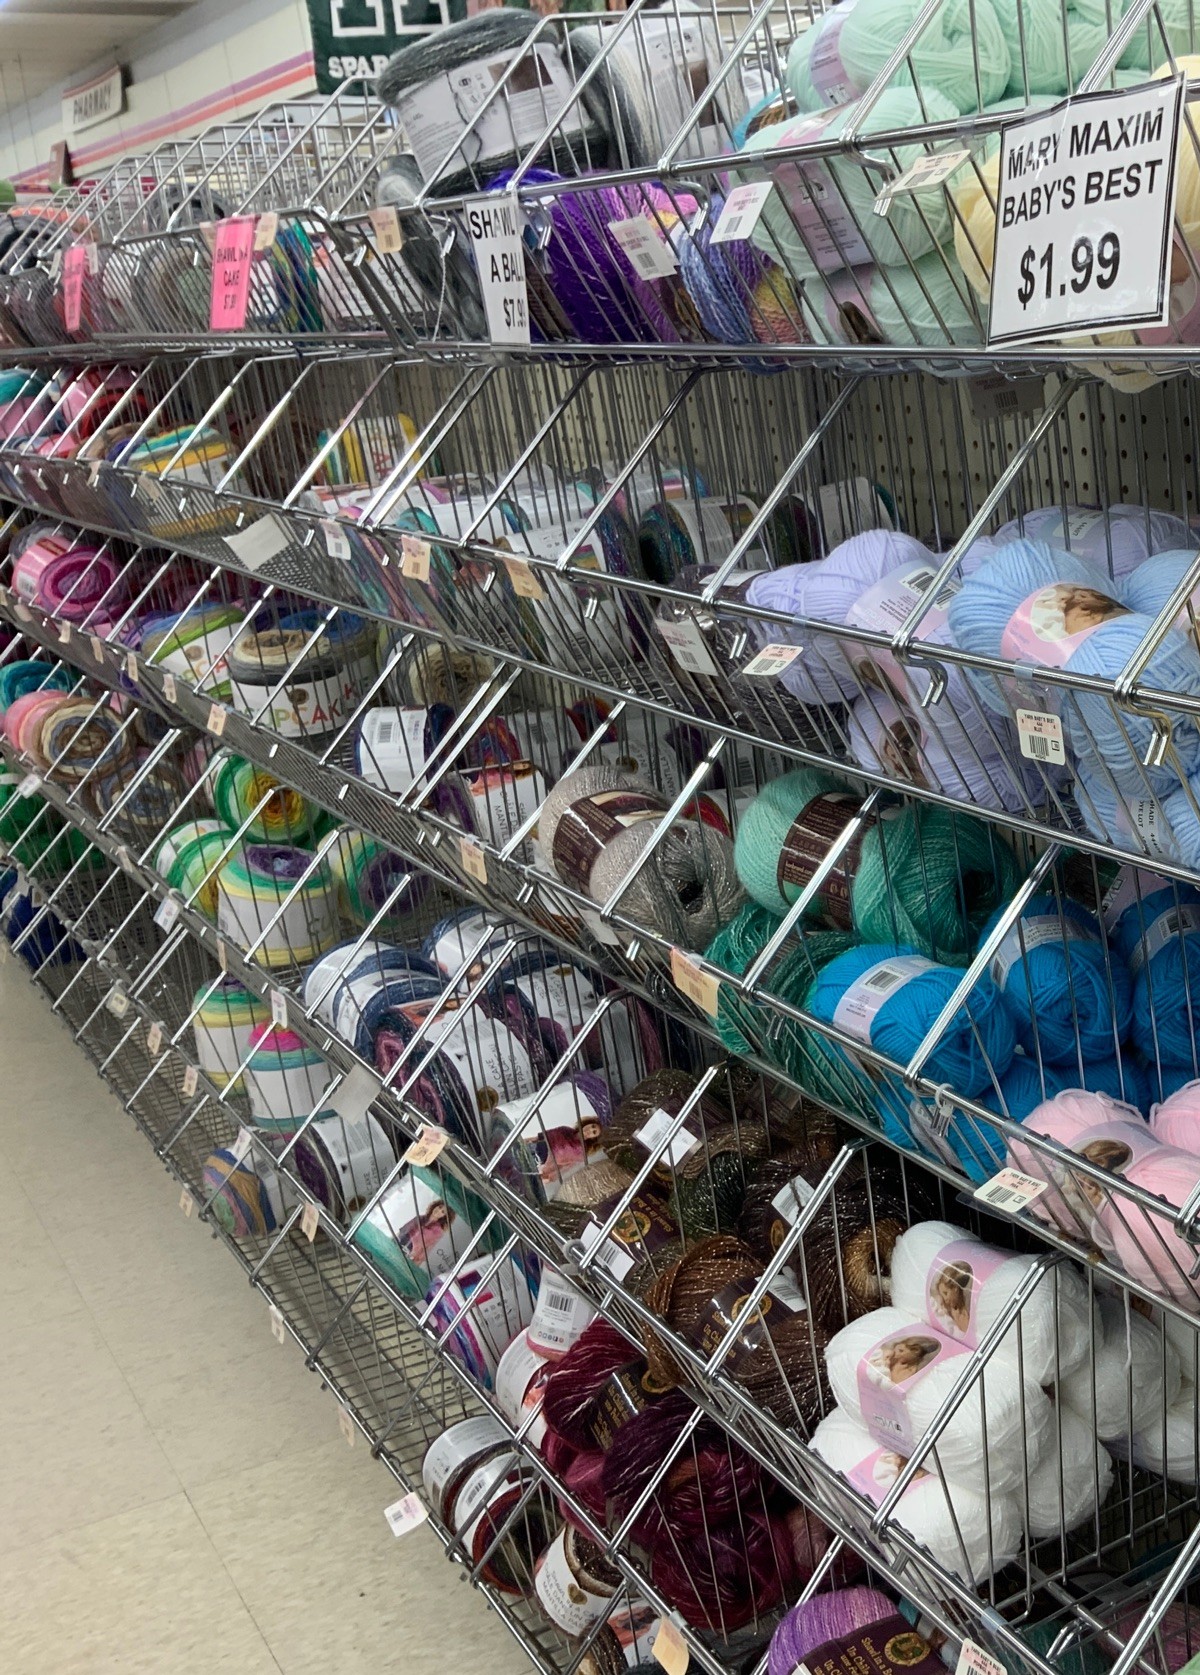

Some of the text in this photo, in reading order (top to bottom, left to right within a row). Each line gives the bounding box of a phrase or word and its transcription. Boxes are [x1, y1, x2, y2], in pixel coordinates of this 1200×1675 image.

[1008, 106, 1165, 181] MARY MAXIM
[1003, 159, 1163, 229] BABY'S BEST
[469, 205, 516, 240] SHAWL
[490, 254, 501, 283] A
[1017, 230, 1121, 311] $1.99
[861, 1636, 881, 1658] Shawl
